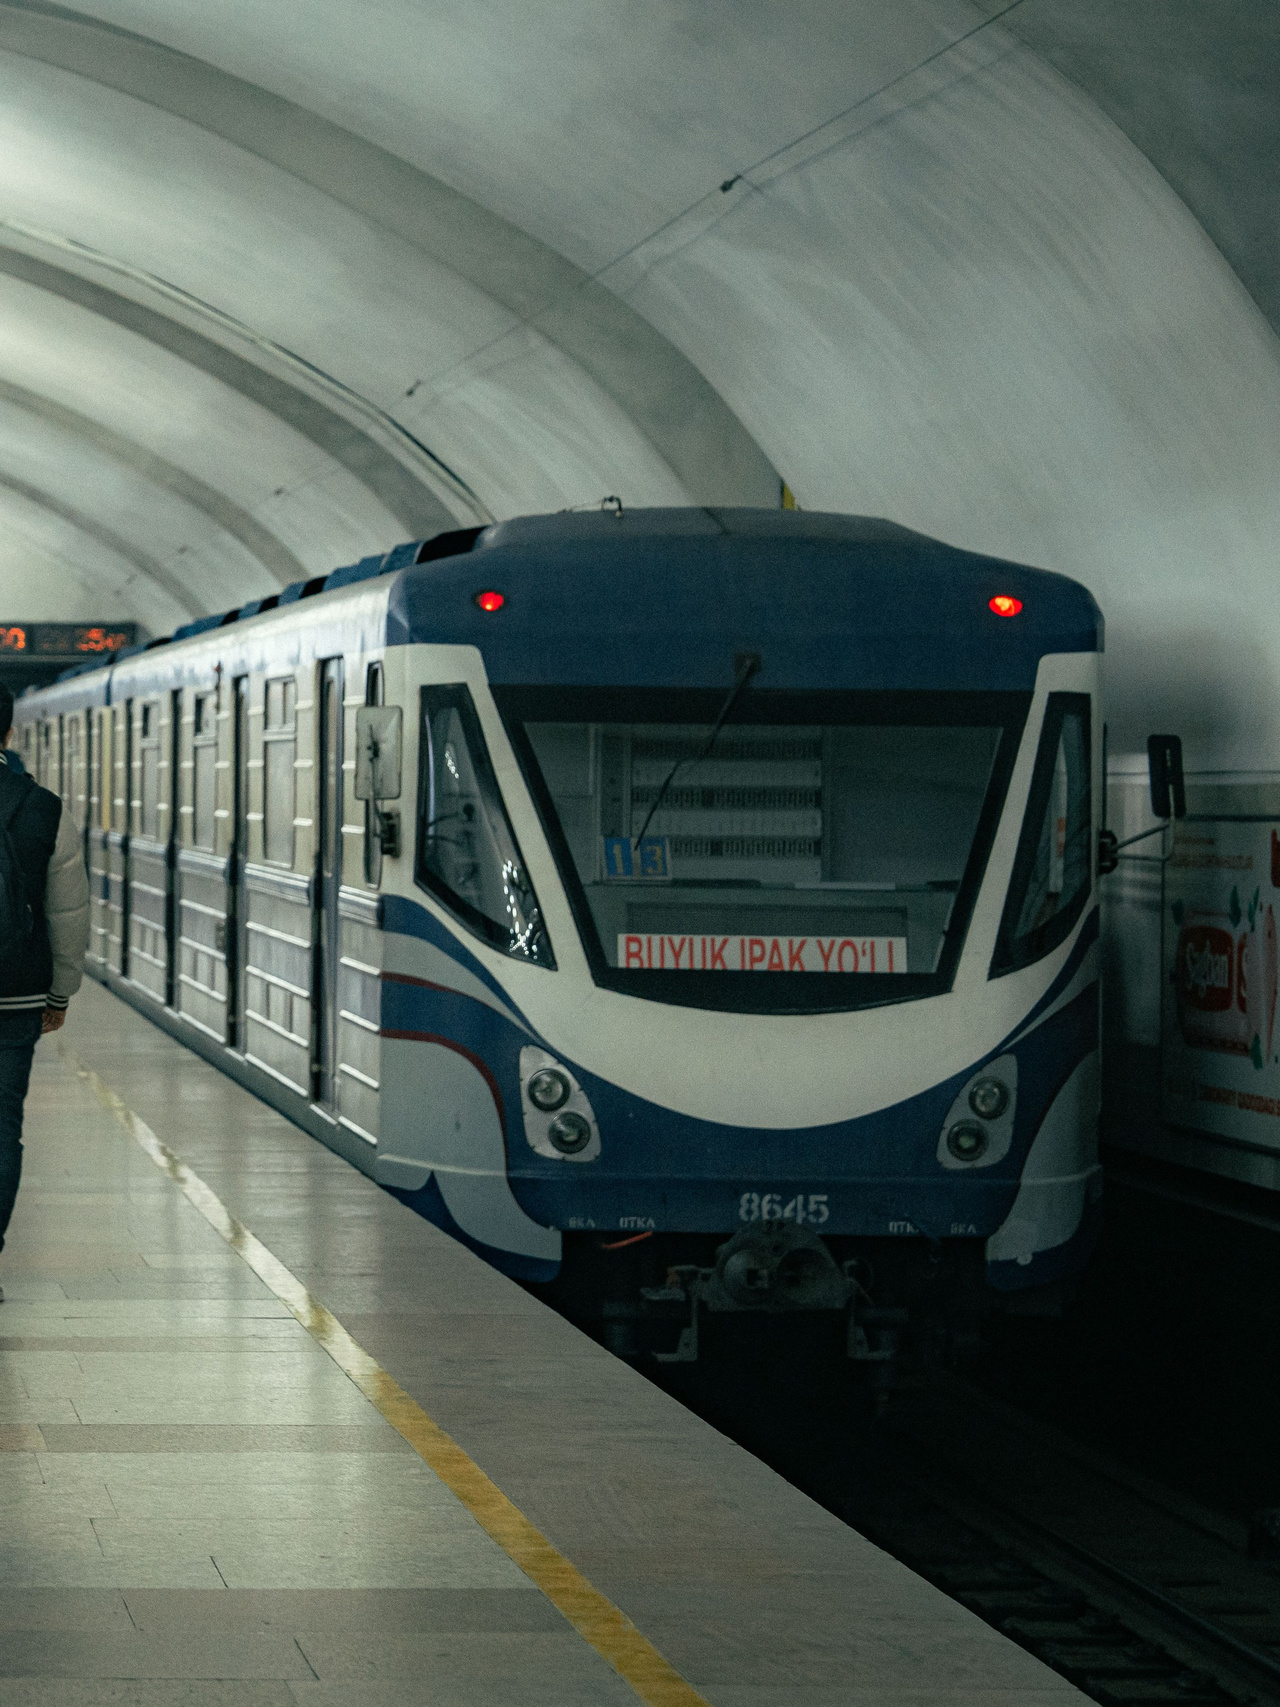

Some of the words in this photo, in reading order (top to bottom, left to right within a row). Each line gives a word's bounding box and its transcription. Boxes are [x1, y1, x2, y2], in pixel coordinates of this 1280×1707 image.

[625, 936, 729, 970] BUYUK
[740, 938, 808, 972] IPAK
[738, 1191, 830, 1225] 8645
